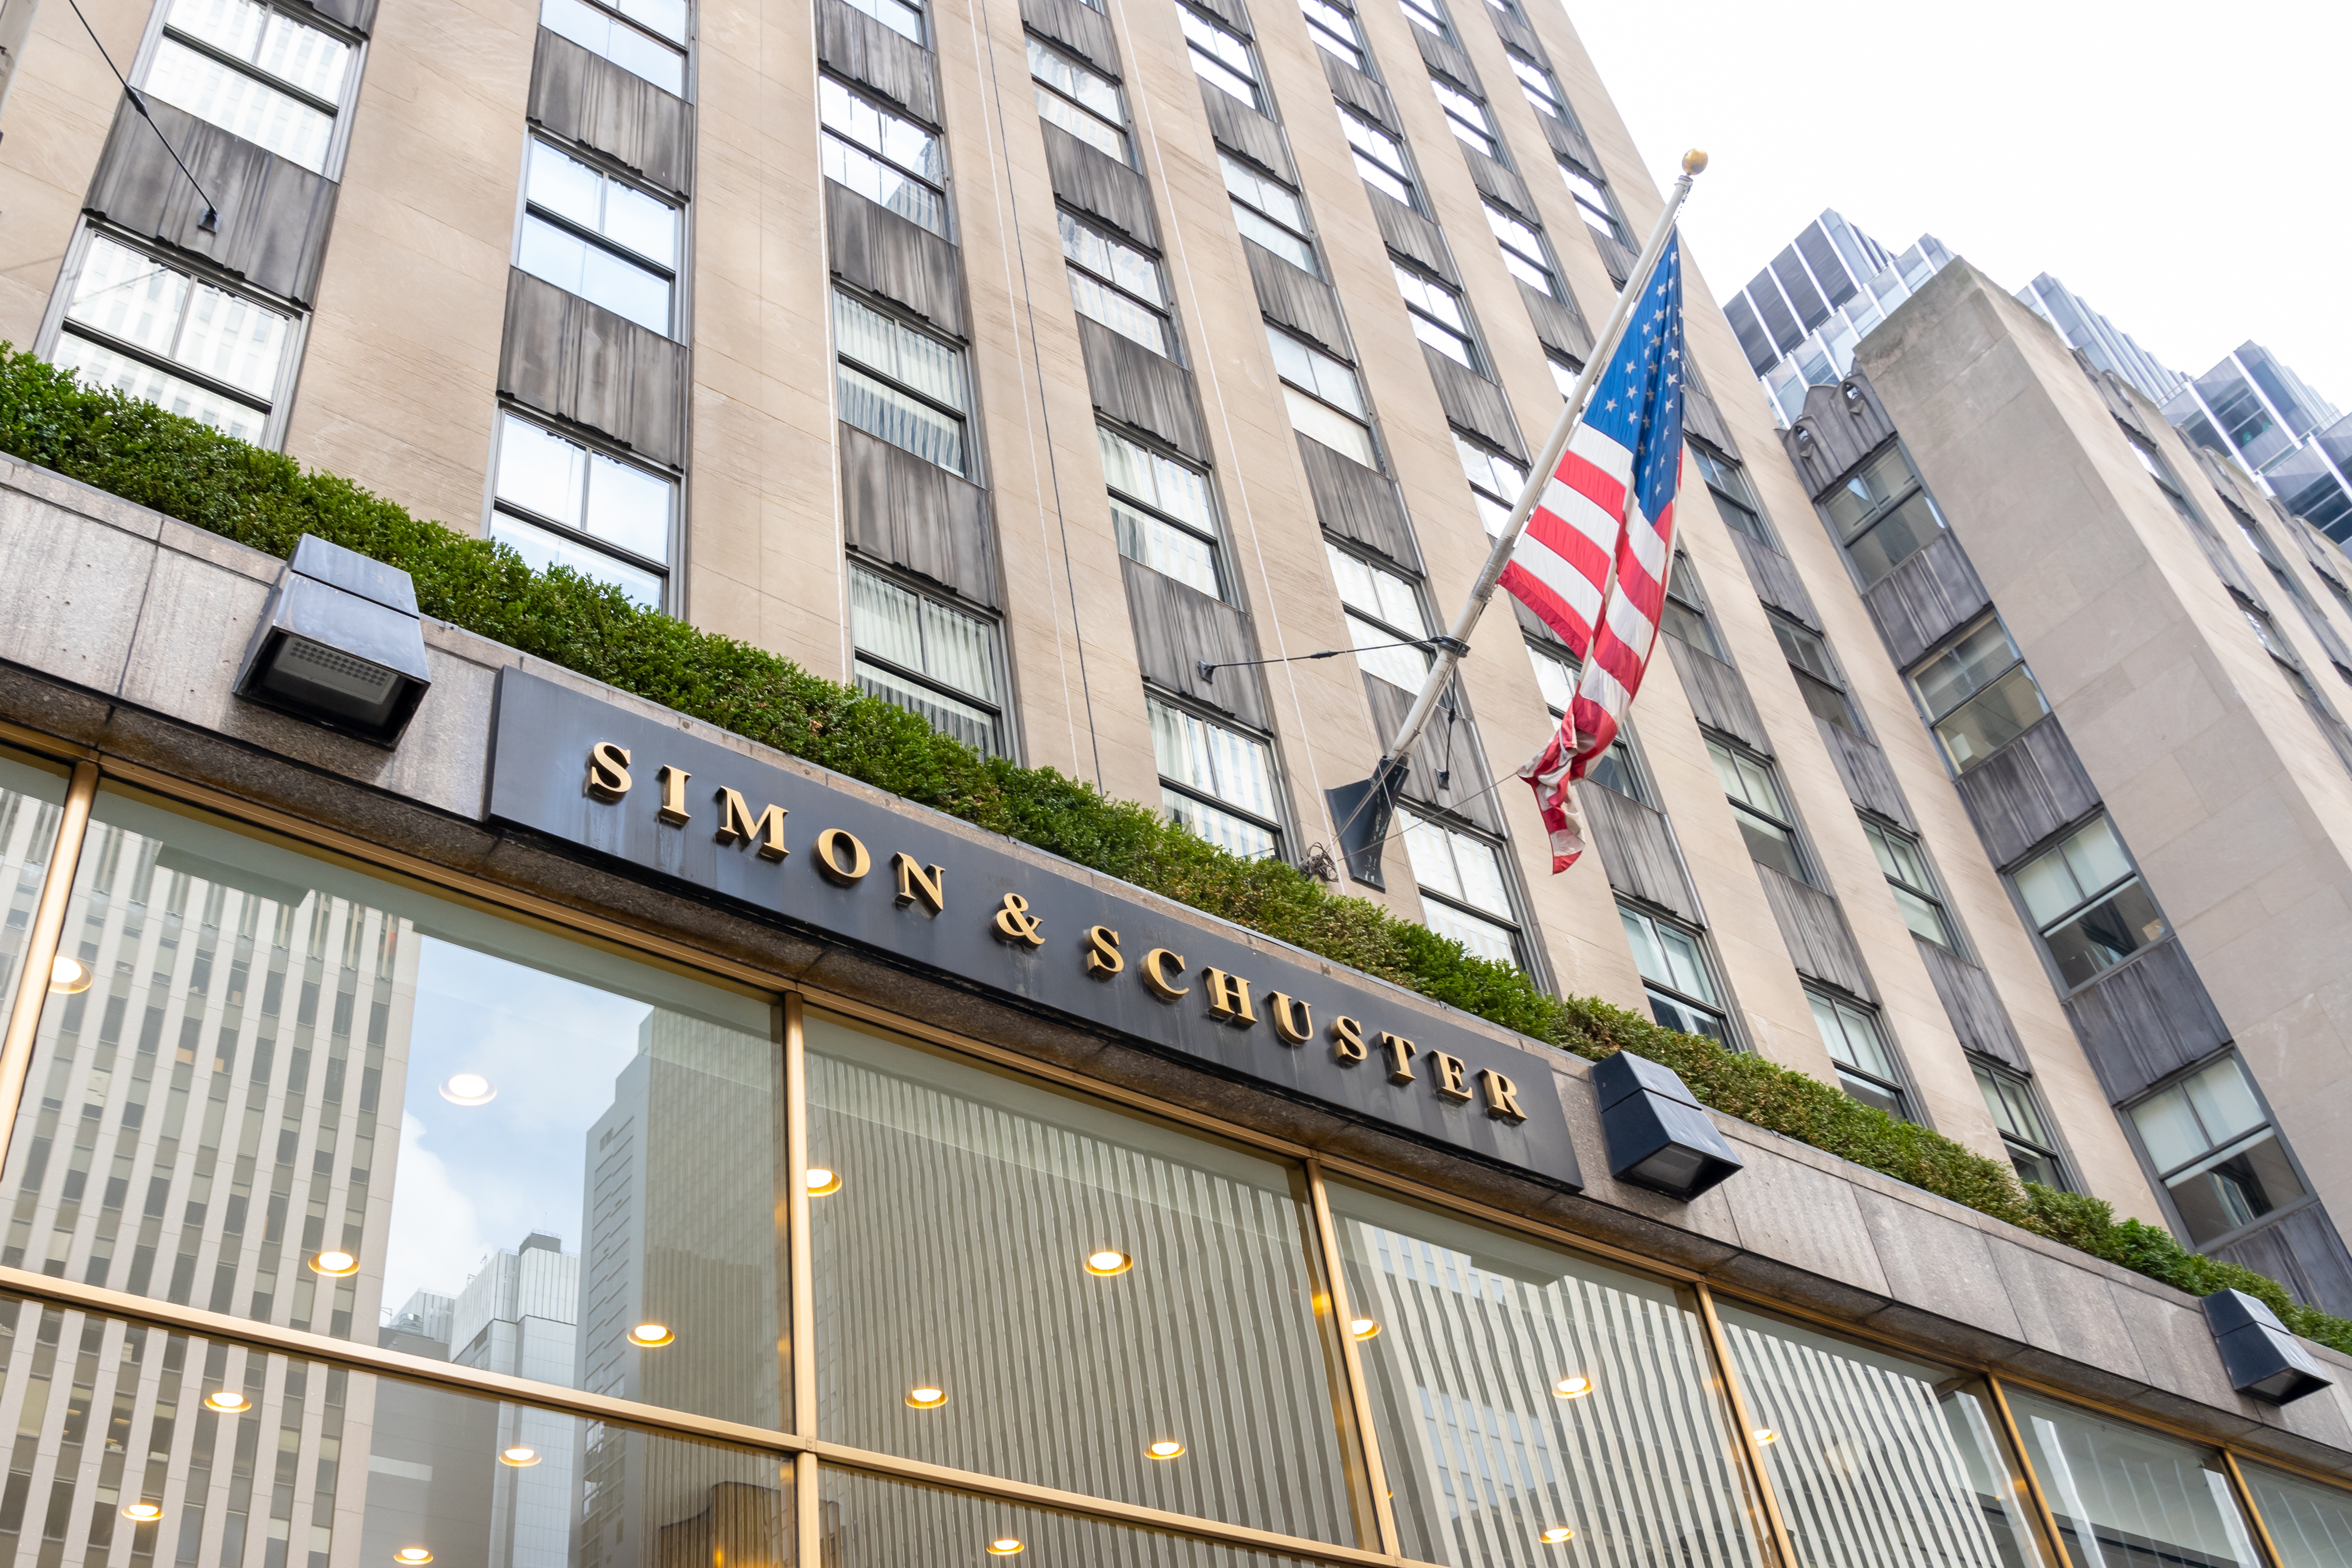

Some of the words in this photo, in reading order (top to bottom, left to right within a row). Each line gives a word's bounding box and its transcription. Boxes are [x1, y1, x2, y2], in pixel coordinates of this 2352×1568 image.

[587, 741, 946, 914] SIMON
[993, 892, 1045, 948] &
[1086, 925, 1528, 1122] SCHUSTER
